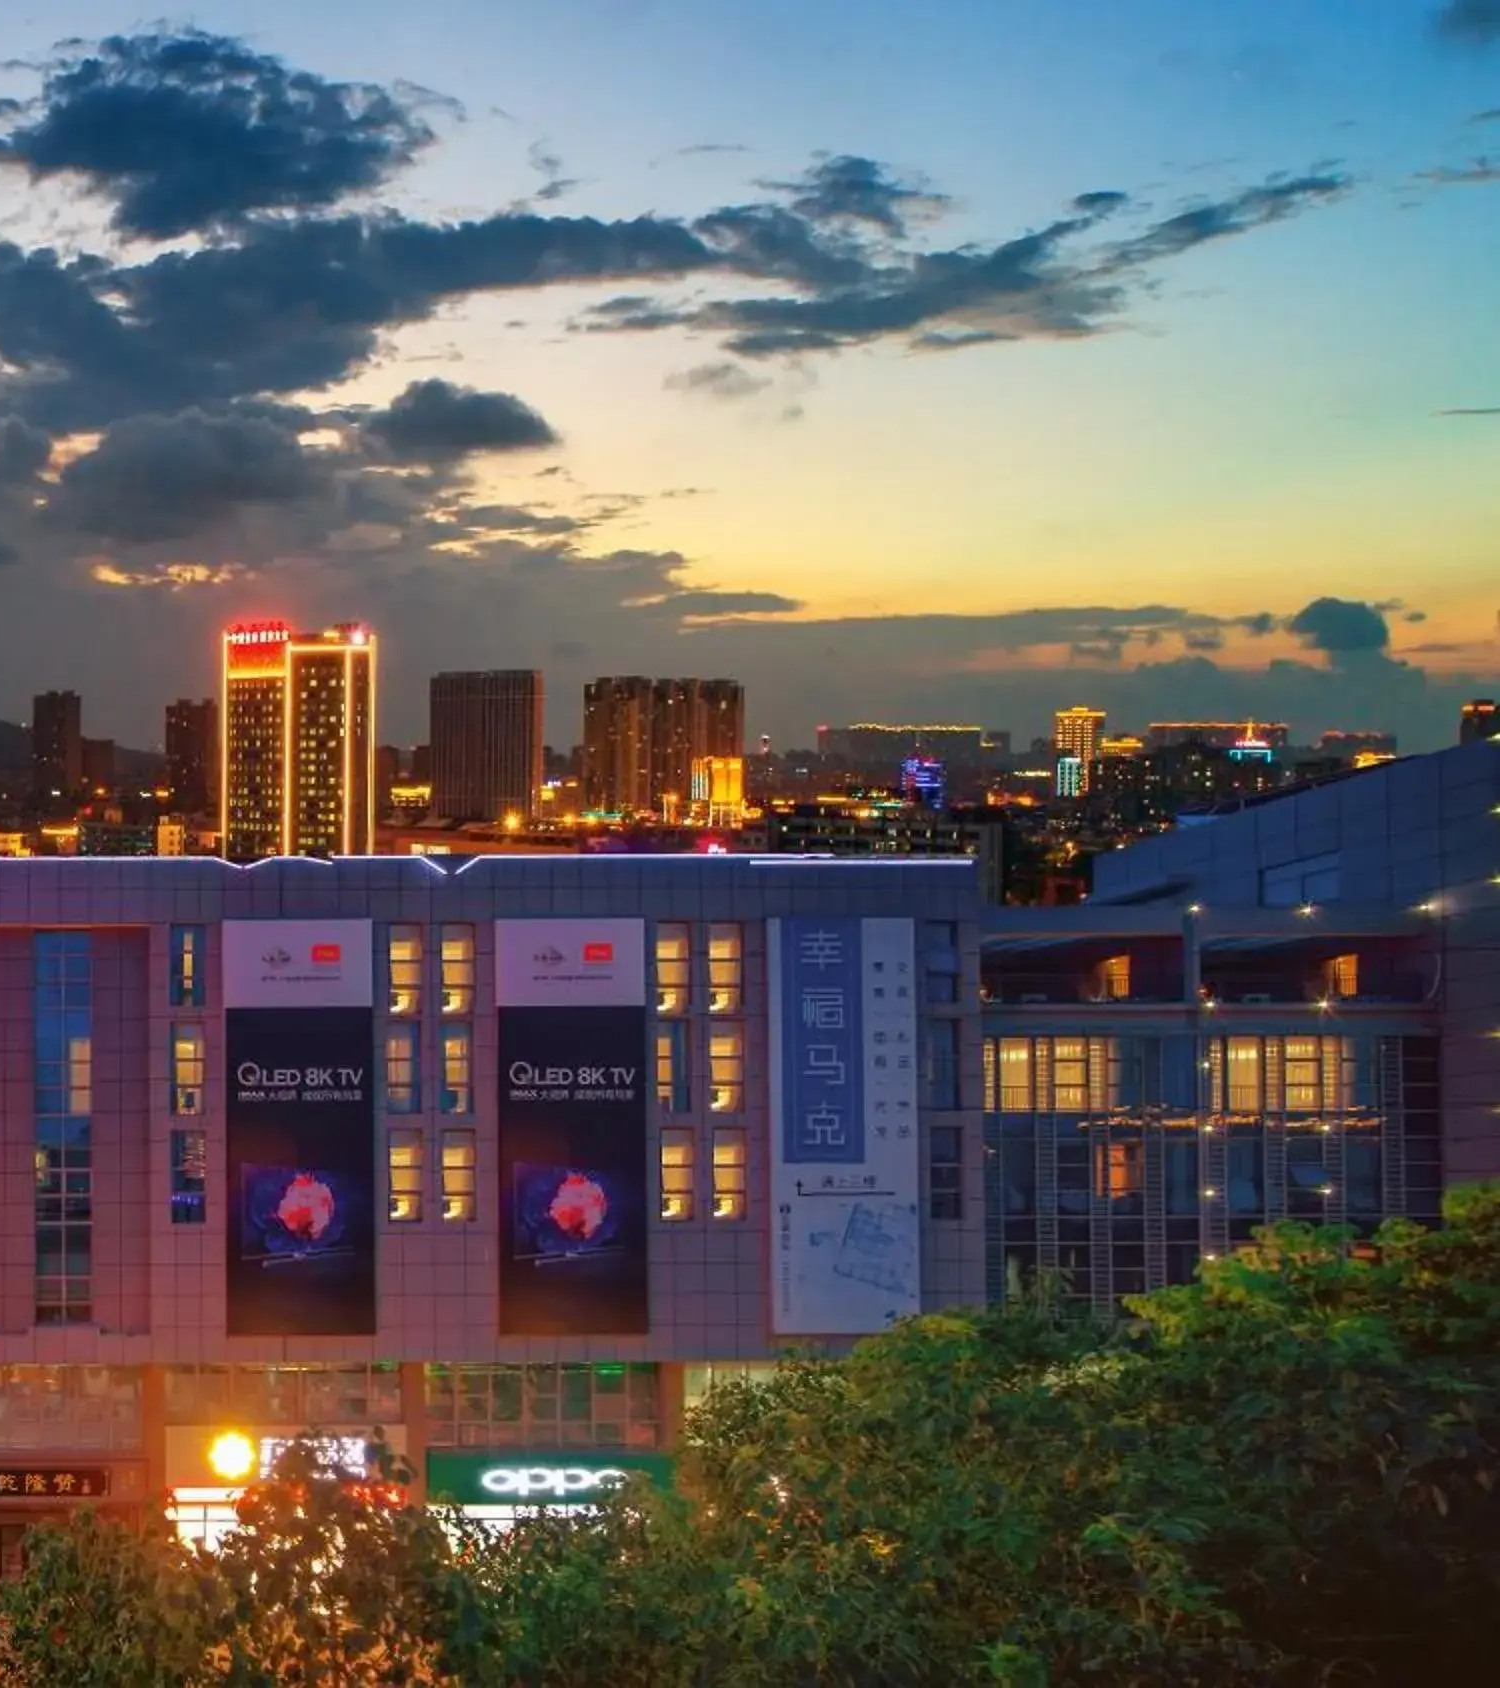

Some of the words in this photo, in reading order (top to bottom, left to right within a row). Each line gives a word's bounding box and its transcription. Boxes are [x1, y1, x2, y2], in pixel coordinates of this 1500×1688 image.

[800, 928, 845, 1145] 幸福马克
[237, 1061, 301, 1087] QLED
[304, 1066, 335, 1087] 8K
[337, 1067, 363, 1086] TV
[509, 1061, 574, 1086] QLED
[577, 1066, 607, 1086] 8K
[609, 1067, 636, 1086] TV
